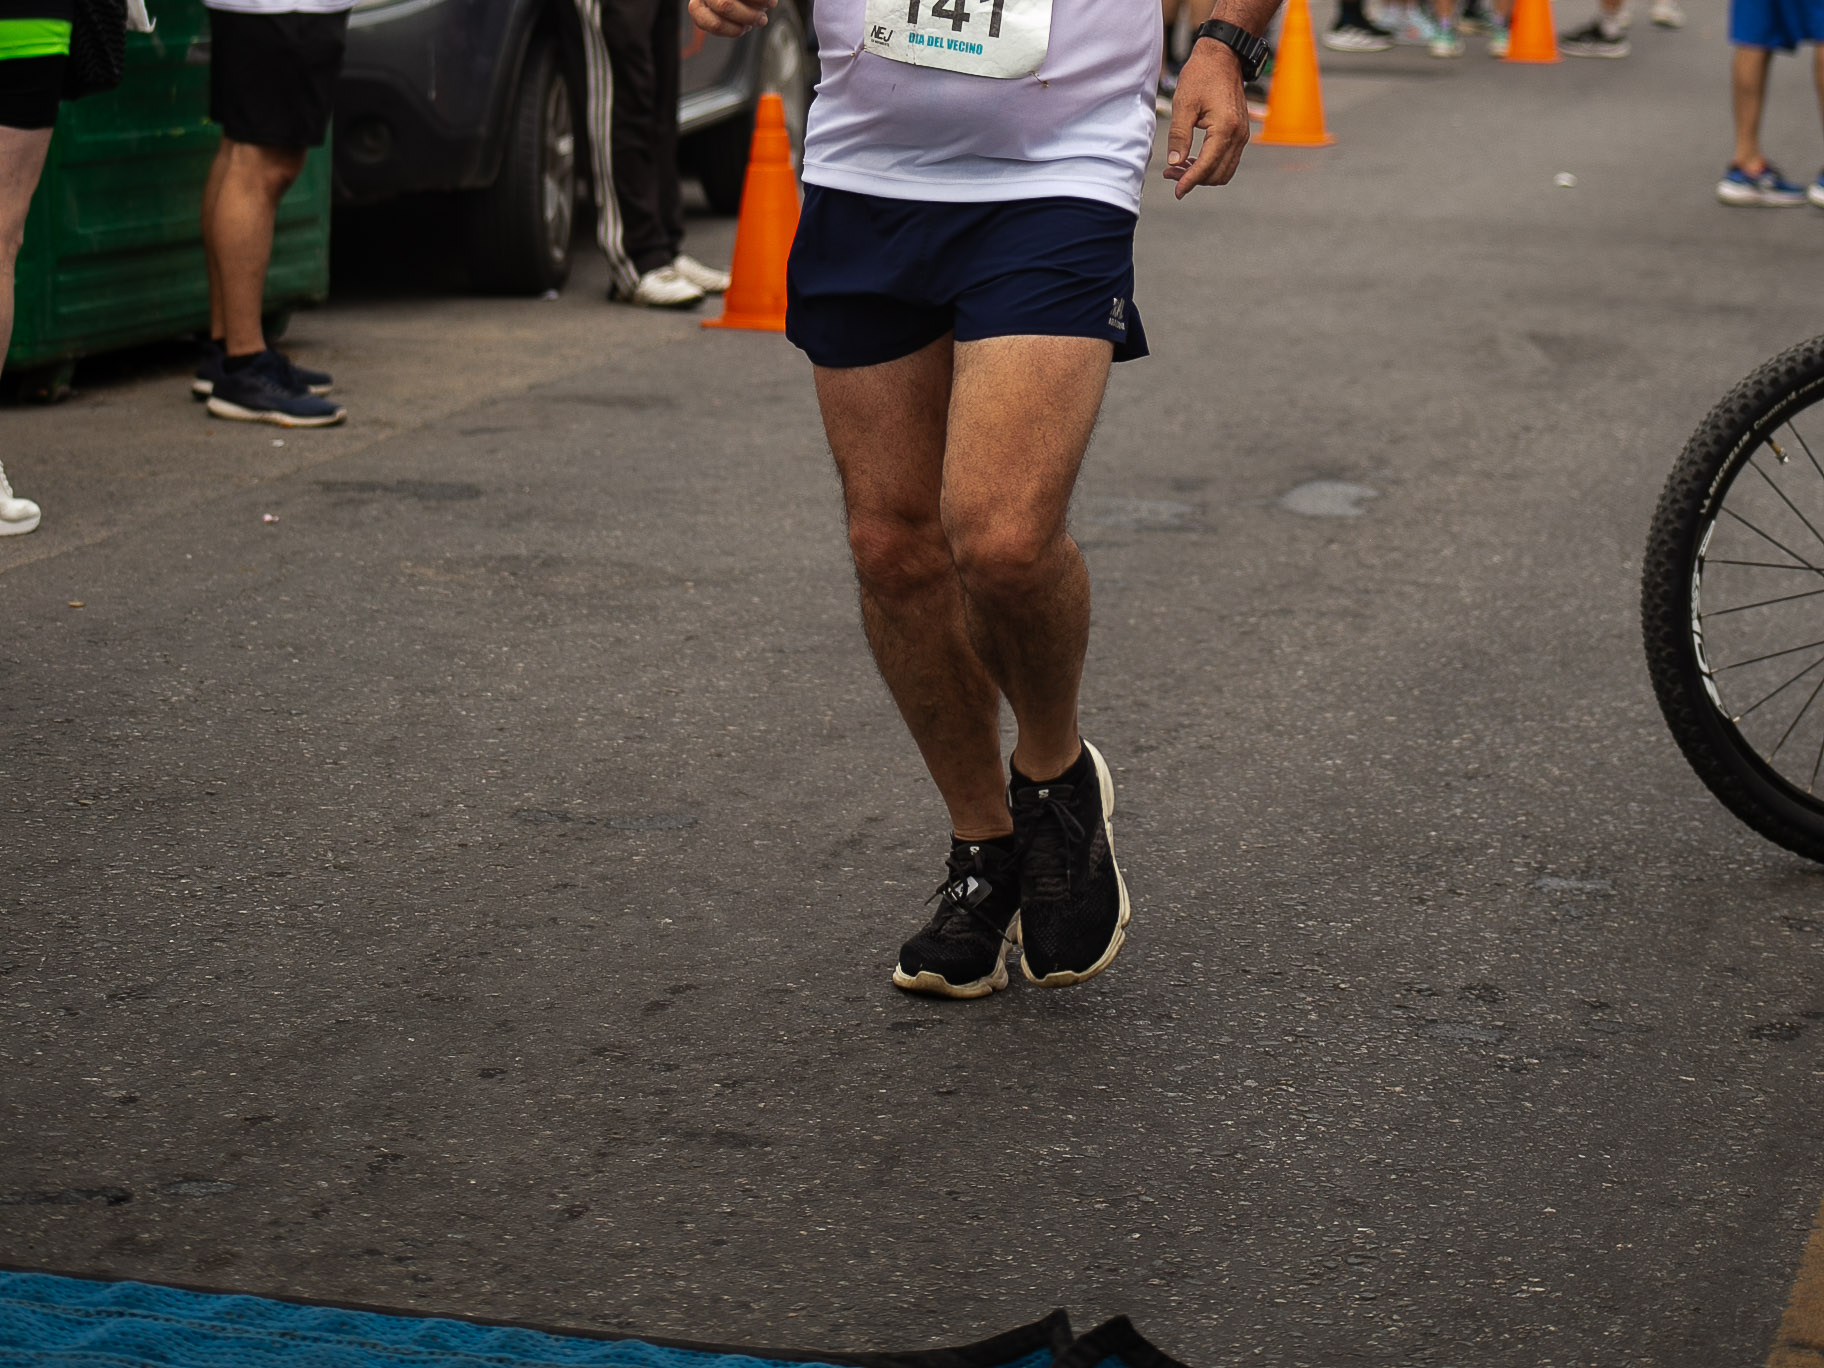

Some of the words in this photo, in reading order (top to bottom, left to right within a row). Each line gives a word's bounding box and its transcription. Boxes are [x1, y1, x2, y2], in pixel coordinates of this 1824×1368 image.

[926, 35, 944, 49] DEL
[946, 38, 984, 56] VECINO
[1708, 431, 1750, 496] MICHELIN
